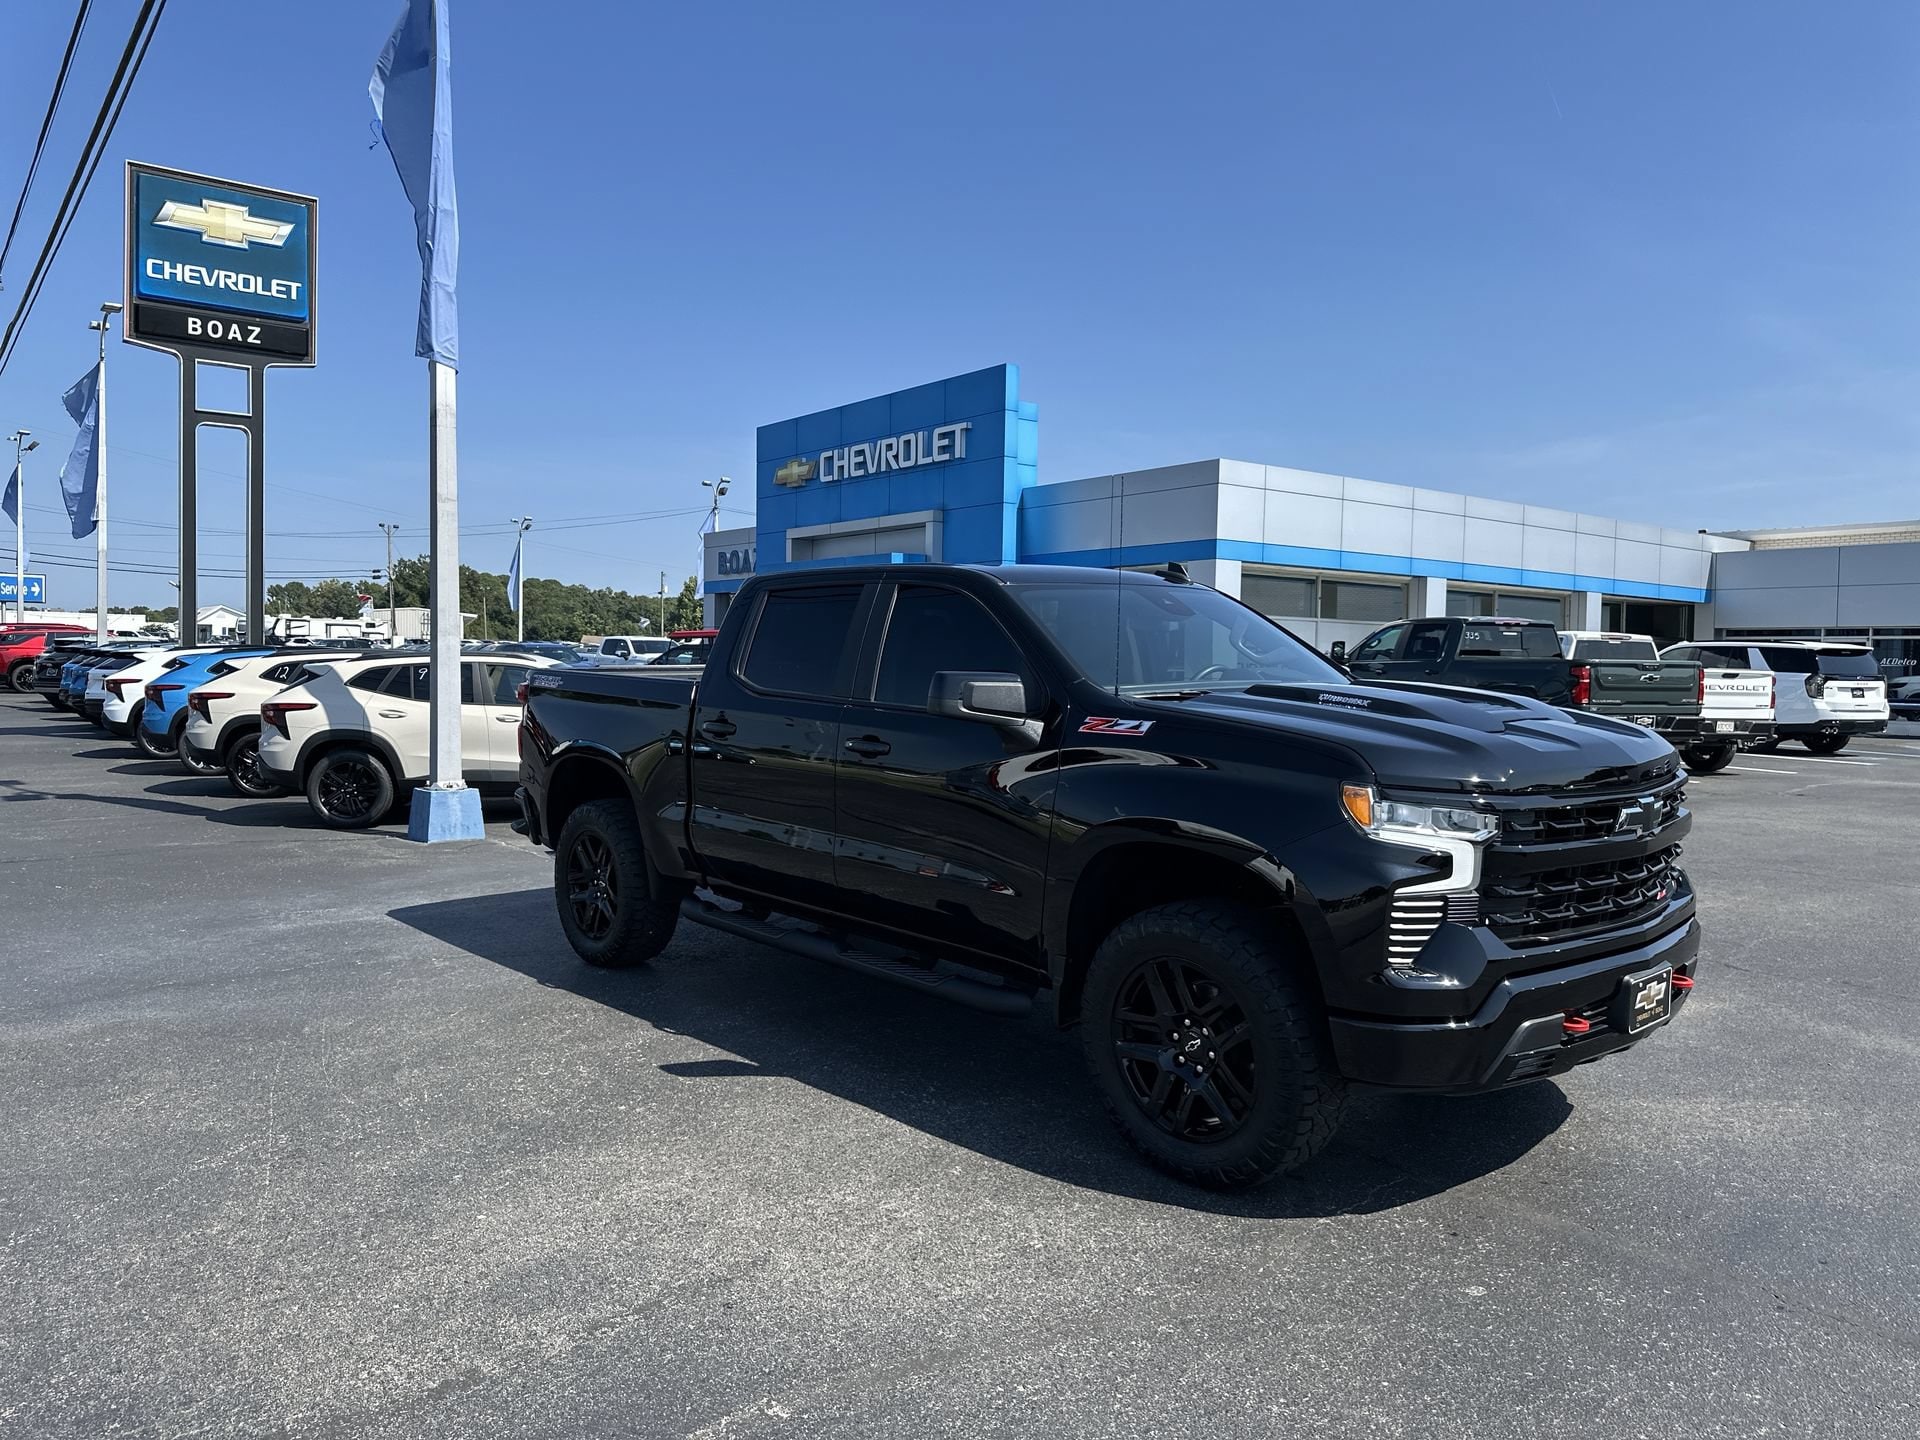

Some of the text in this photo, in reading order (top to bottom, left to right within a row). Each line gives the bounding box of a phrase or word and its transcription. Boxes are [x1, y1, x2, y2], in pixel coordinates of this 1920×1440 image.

[146, 258, 302, 300] CHEVROLET
[187, 316, 262, 345] BOAZ
[819, 421, 973, 483] CHEVROLET
[0, 582, 28, 596] Serve
[1465, 631, 1480, 640] 335
[274, 666, 290, 680] 12
[418, 667, 428, 681] 9
[1704, 684, 1768, 692] EVROLET
[1078, 716, 1157, 736] Z71
